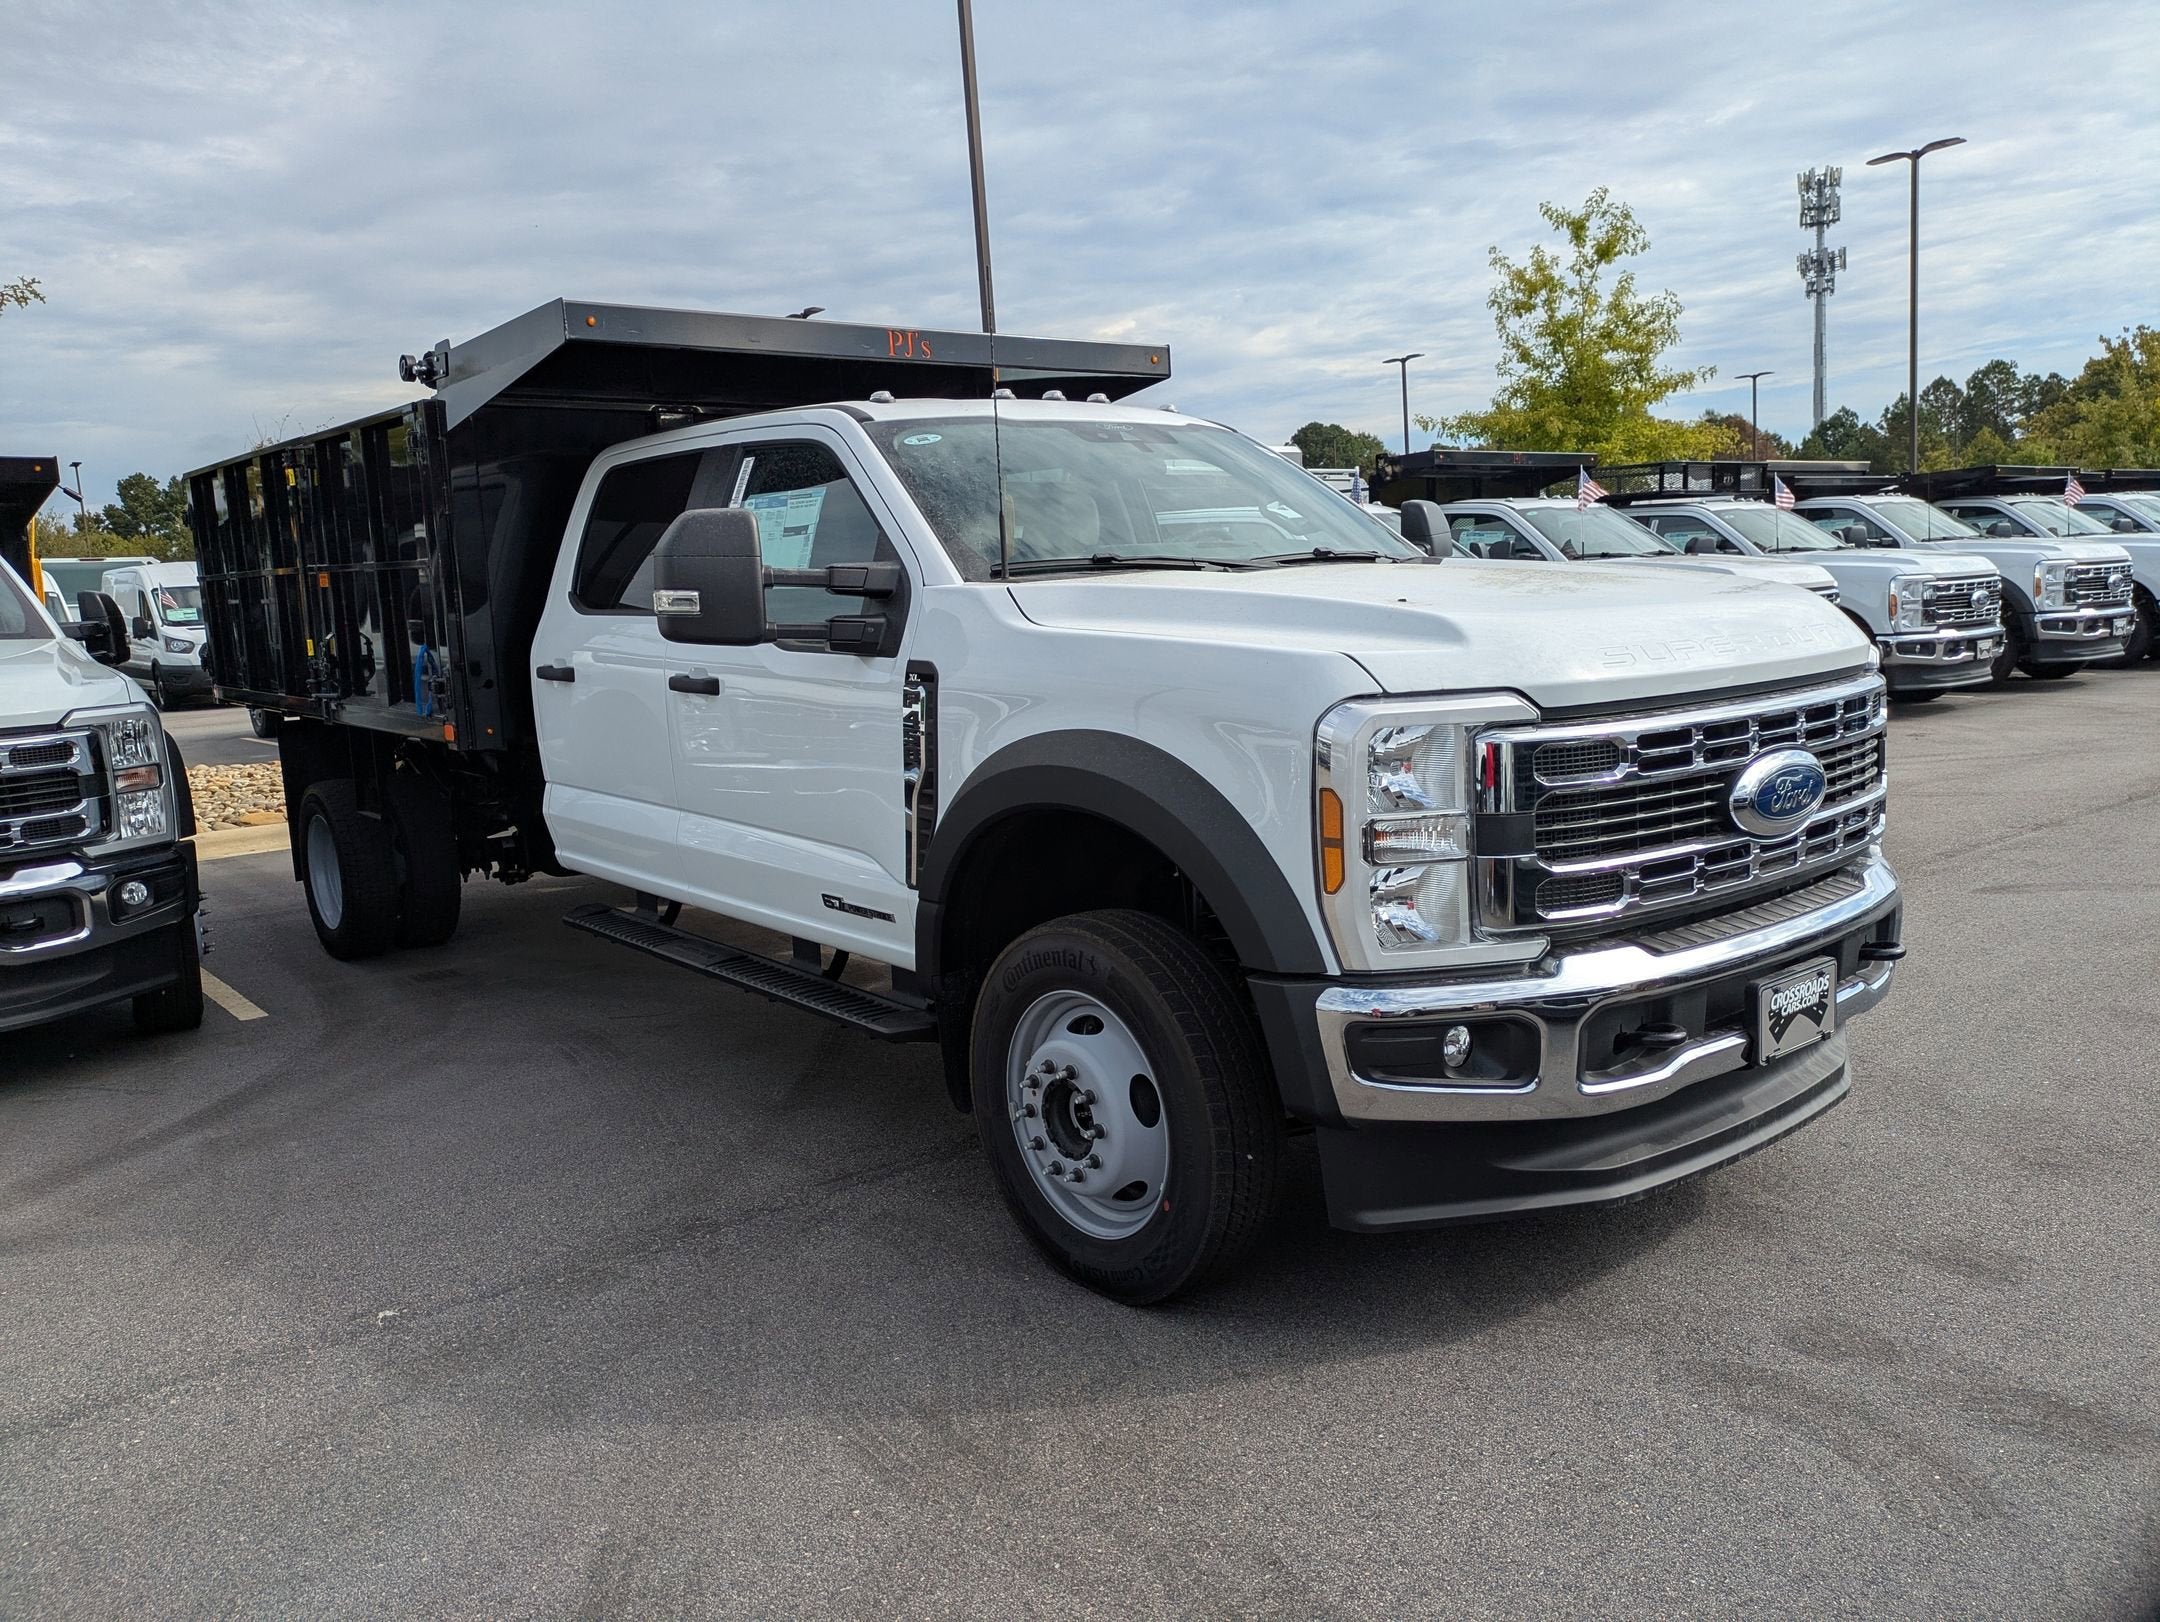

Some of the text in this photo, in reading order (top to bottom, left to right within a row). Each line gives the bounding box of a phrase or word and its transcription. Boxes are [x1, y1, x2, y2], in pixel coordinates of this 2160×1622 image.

[887, 330, 931, 359] PJ's
[908, 673, 920, 682] XL
[1770, 774, 1815, 813] Ford
[1003, 948, 1084, 993] Continental
[1770, 974, 1830, 1011] CROSSROADS
[1781, 991, 1819, 1017] CARS.COM
